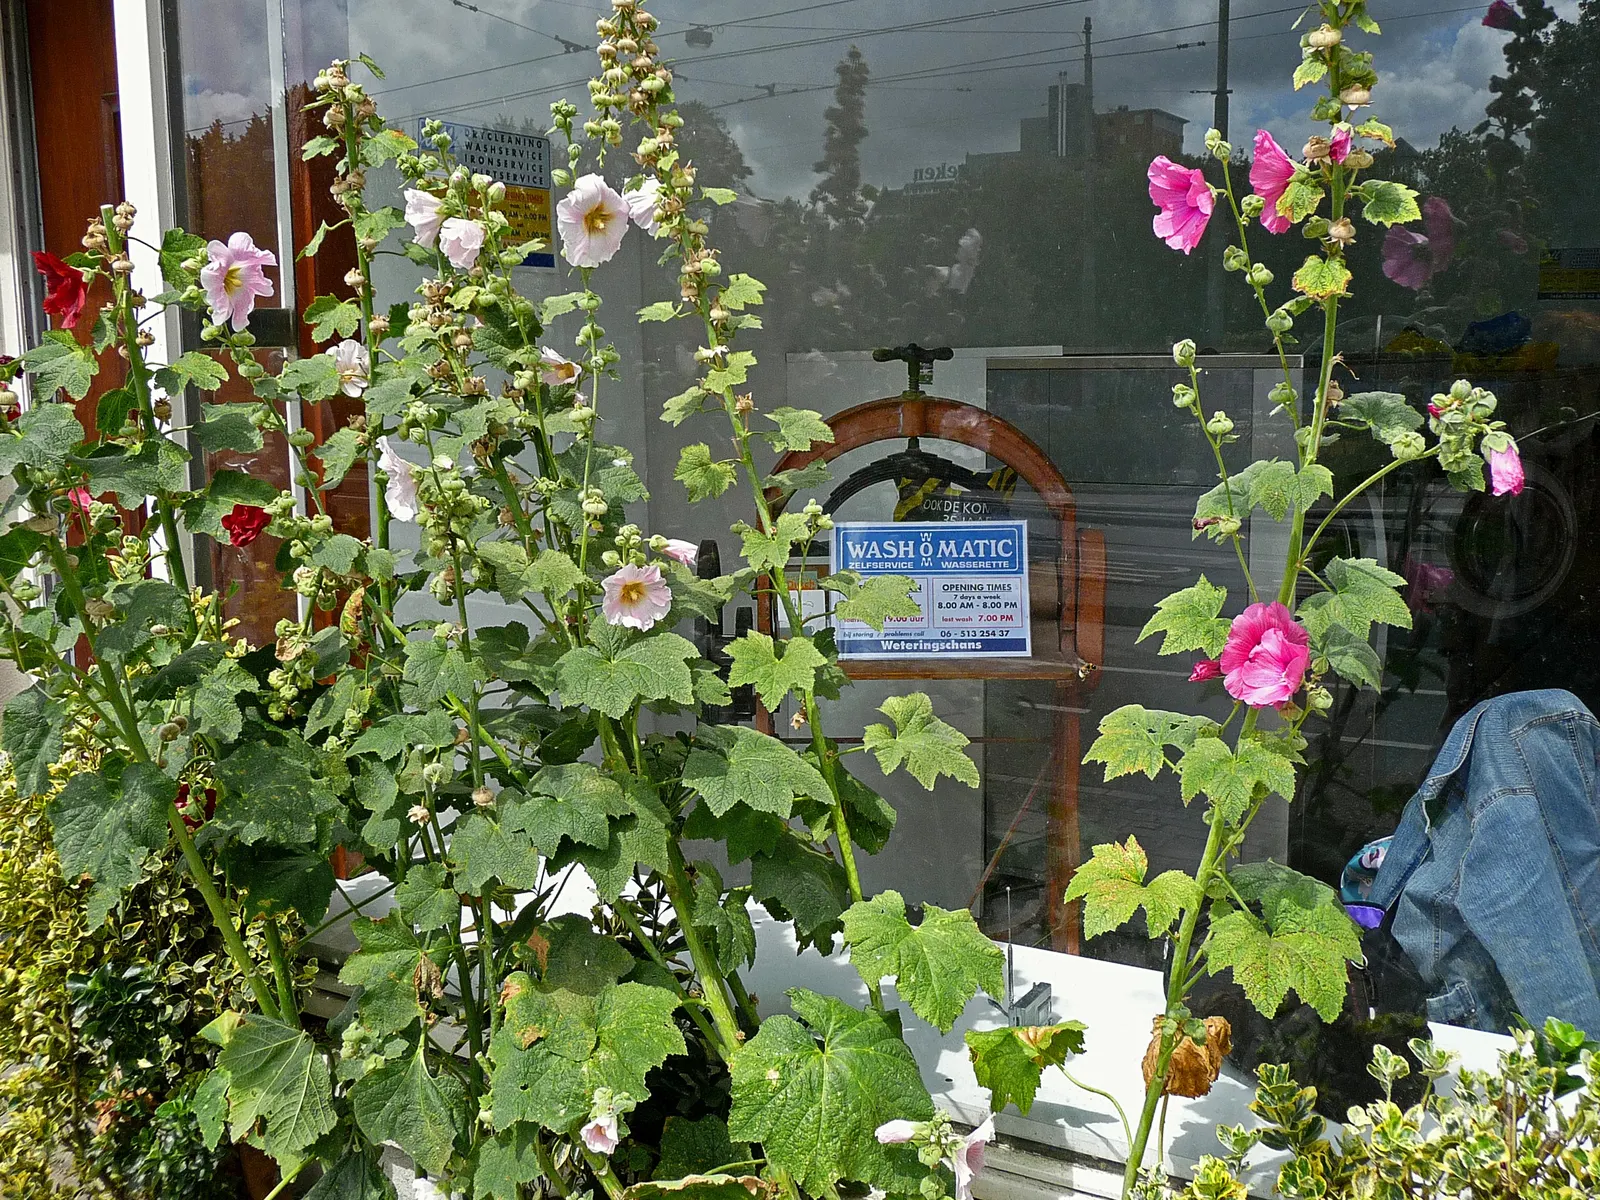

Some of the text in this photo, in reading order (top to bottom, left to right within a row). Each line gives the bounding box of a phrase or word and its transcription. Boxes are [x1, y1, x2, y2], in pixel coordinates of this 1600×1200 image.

[465, 128, 543, 149] DRYCLEANING
[465, 141, 543, 161] WASHSERVICE
[464, 154, 544, 173] IRONSERVICE
[472, 168, 544, 185] HIRTSERVICE
[923, 499, 942, 511] OOK
[944, 501, 961, 513] DE
[847, 540, 915, 558] WASH
[937, 539, 1013, 558] MATIC
[941, 561, 1009, 569] WASSERETTE
[942, 583, 1012, 591] OPENING TIMES
[880, 640, 982, 651] Weteringschans
